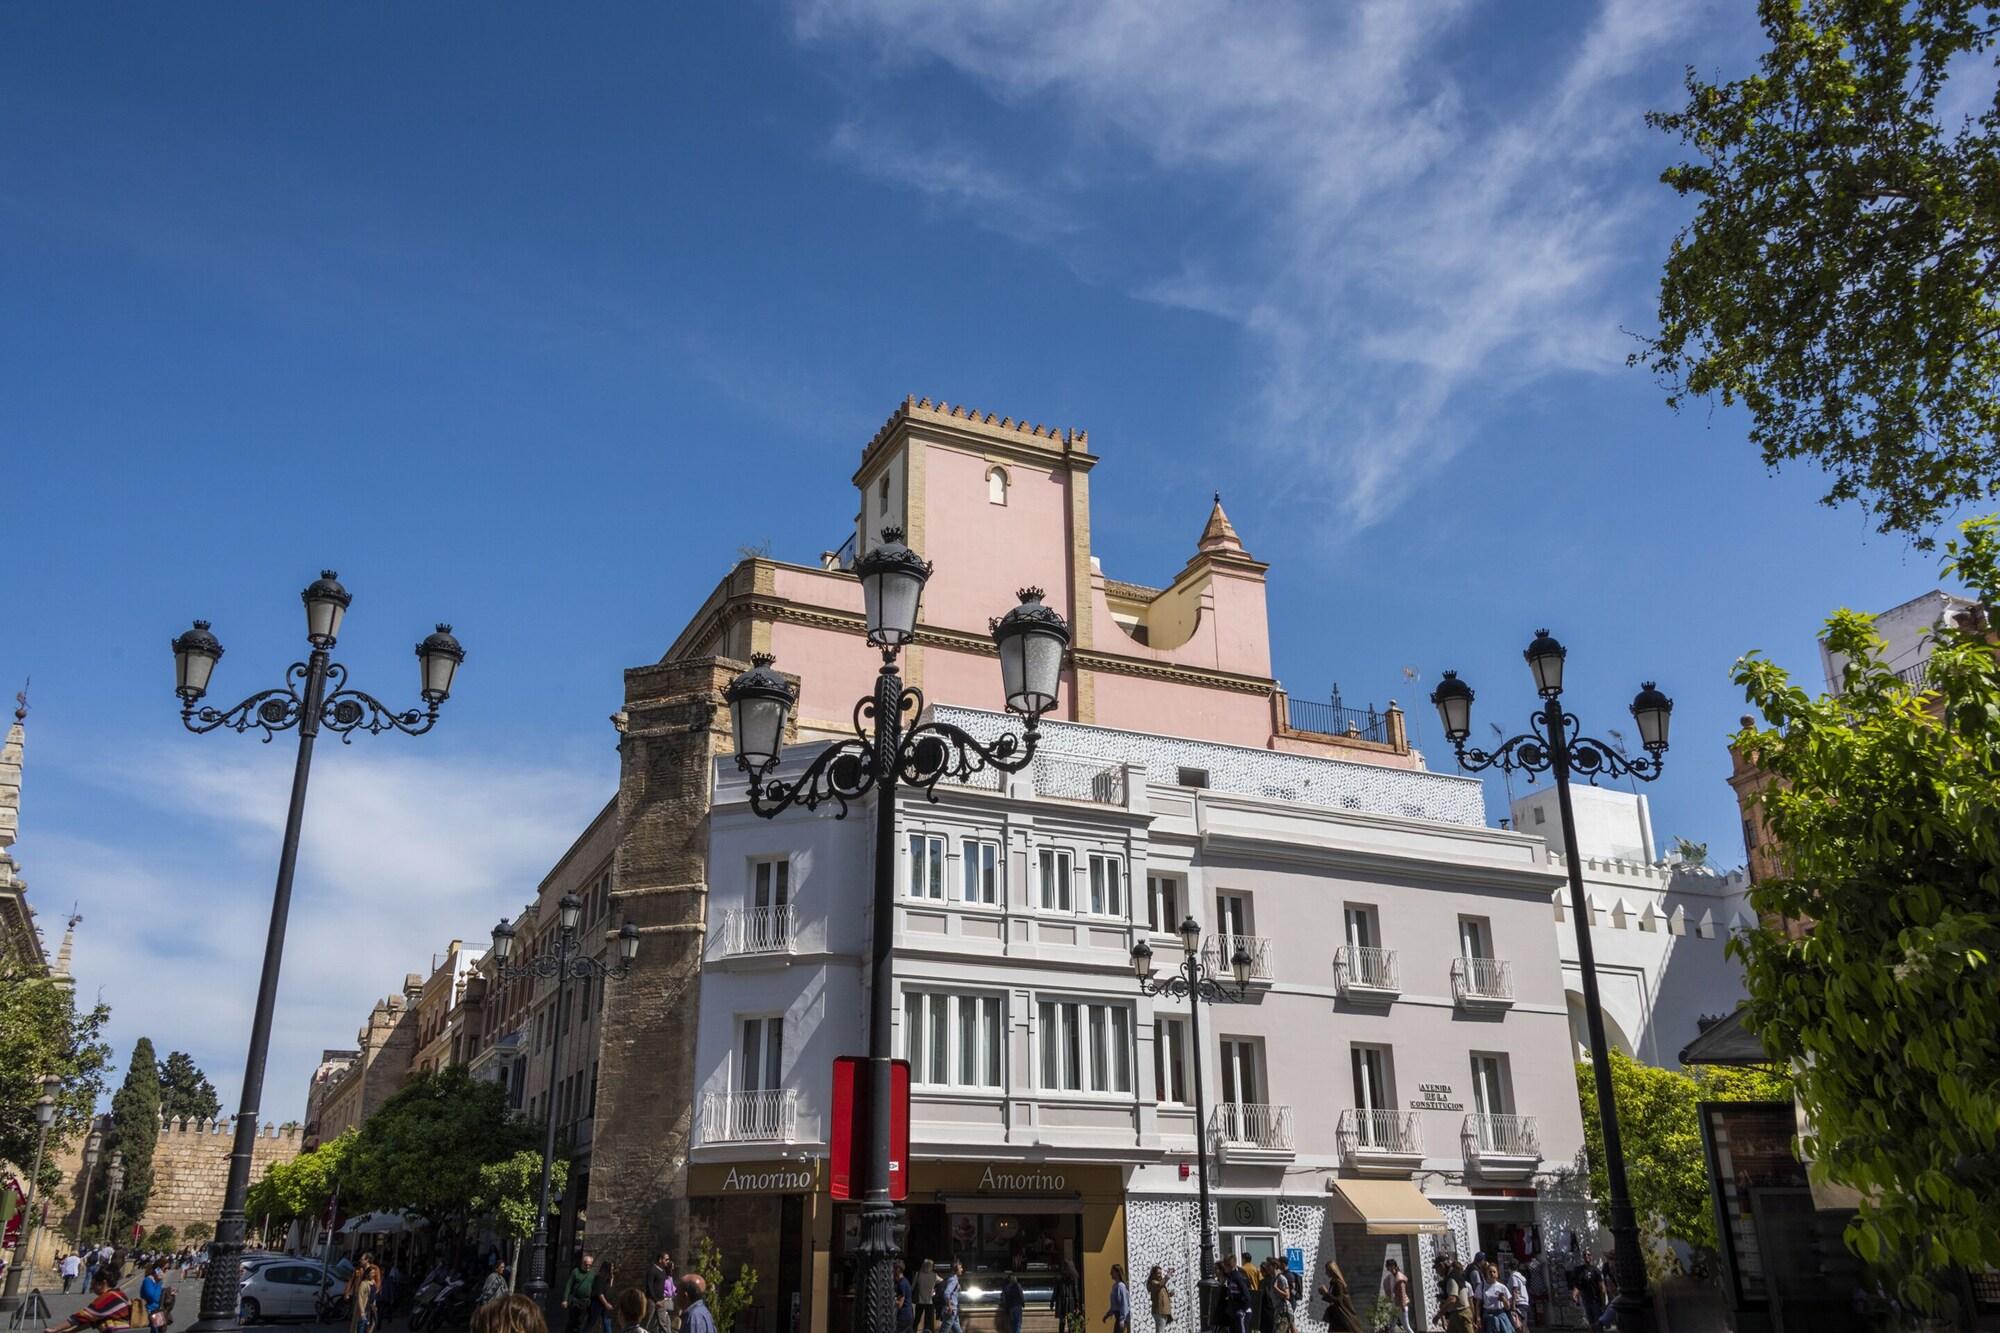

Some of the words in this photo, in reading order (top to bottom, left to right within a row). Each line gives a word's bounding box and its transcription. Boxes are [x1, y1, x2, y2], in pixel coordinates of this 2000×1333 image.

[1419, 1083, 1452, 1093] AVENIDA
[1424, 1093, 1435, 1101] DE
[1437, 1093, 1448, 1101] LA
[722, 1167, 811, 1190] Amorino
[978, 1166, 1065, 1190] Amorino
[1238, 1206, 1252, 1220] 15
[1290, 1250, 1300, 1261] AT
